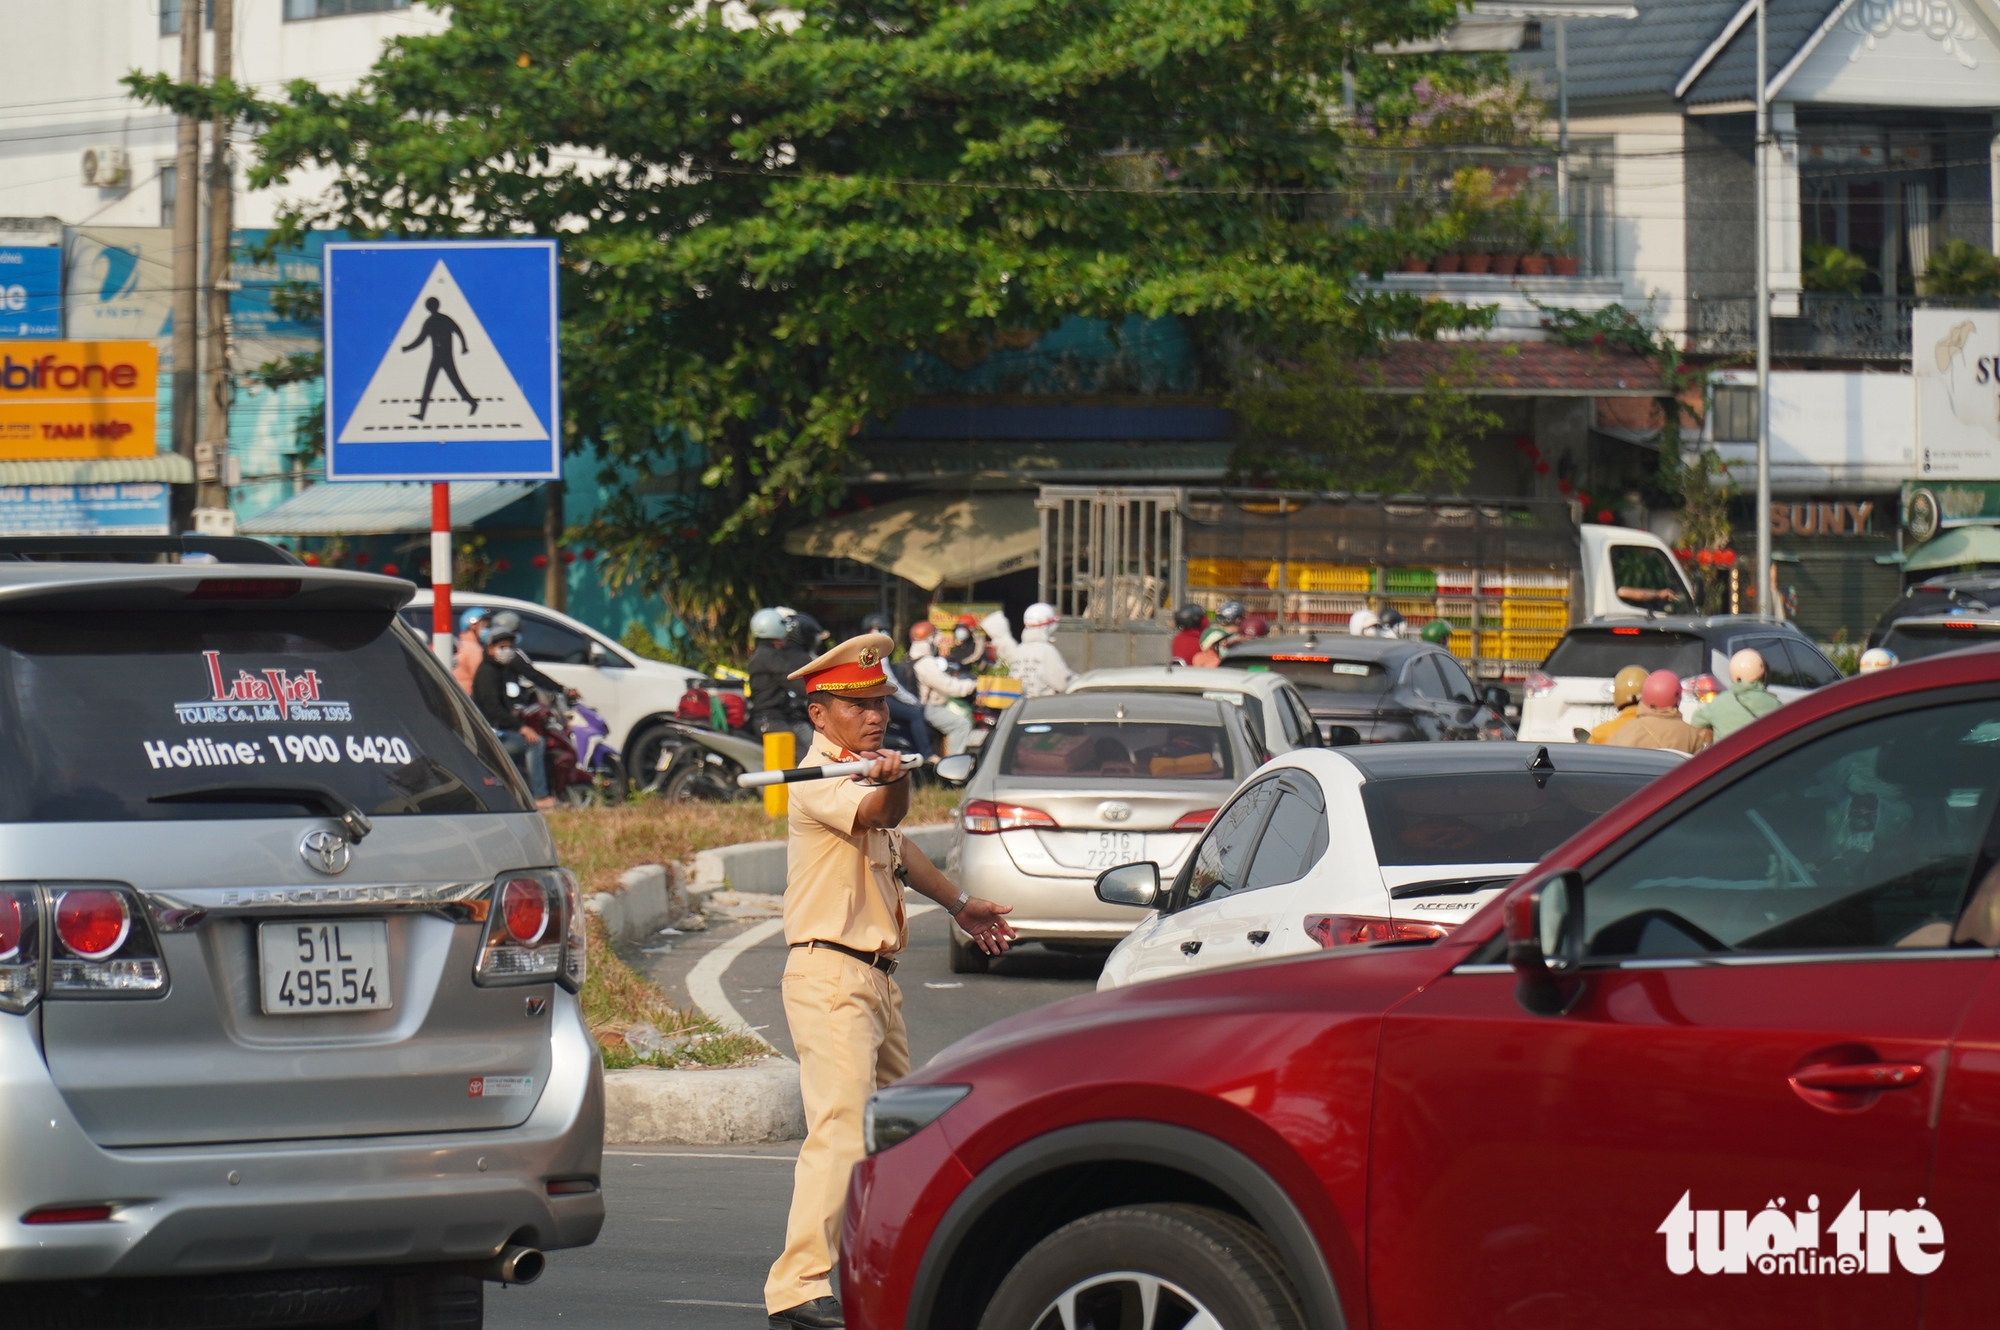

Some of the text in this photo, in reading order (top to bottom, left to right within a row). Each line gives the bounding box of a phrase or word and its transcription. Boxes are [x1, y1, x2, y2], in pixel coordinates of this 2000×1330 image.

[0, 355, 137, 389] bifone
[41, 424, 84, 439] TAM
[1770, 501, 1874, 536] SUNY
[175, 706, 227, 724] TOURS
[143, 735, 411, 769] Hotline: 1900 6420
[1100, 832, 1130, 849] 51G
[221, 888, 438, 905] FORTUNER
[1413, 902, 1480, 911] ACCENT
[297, 926, 352, 963] 51L
[279, 967, 377, 1006] 495.54
